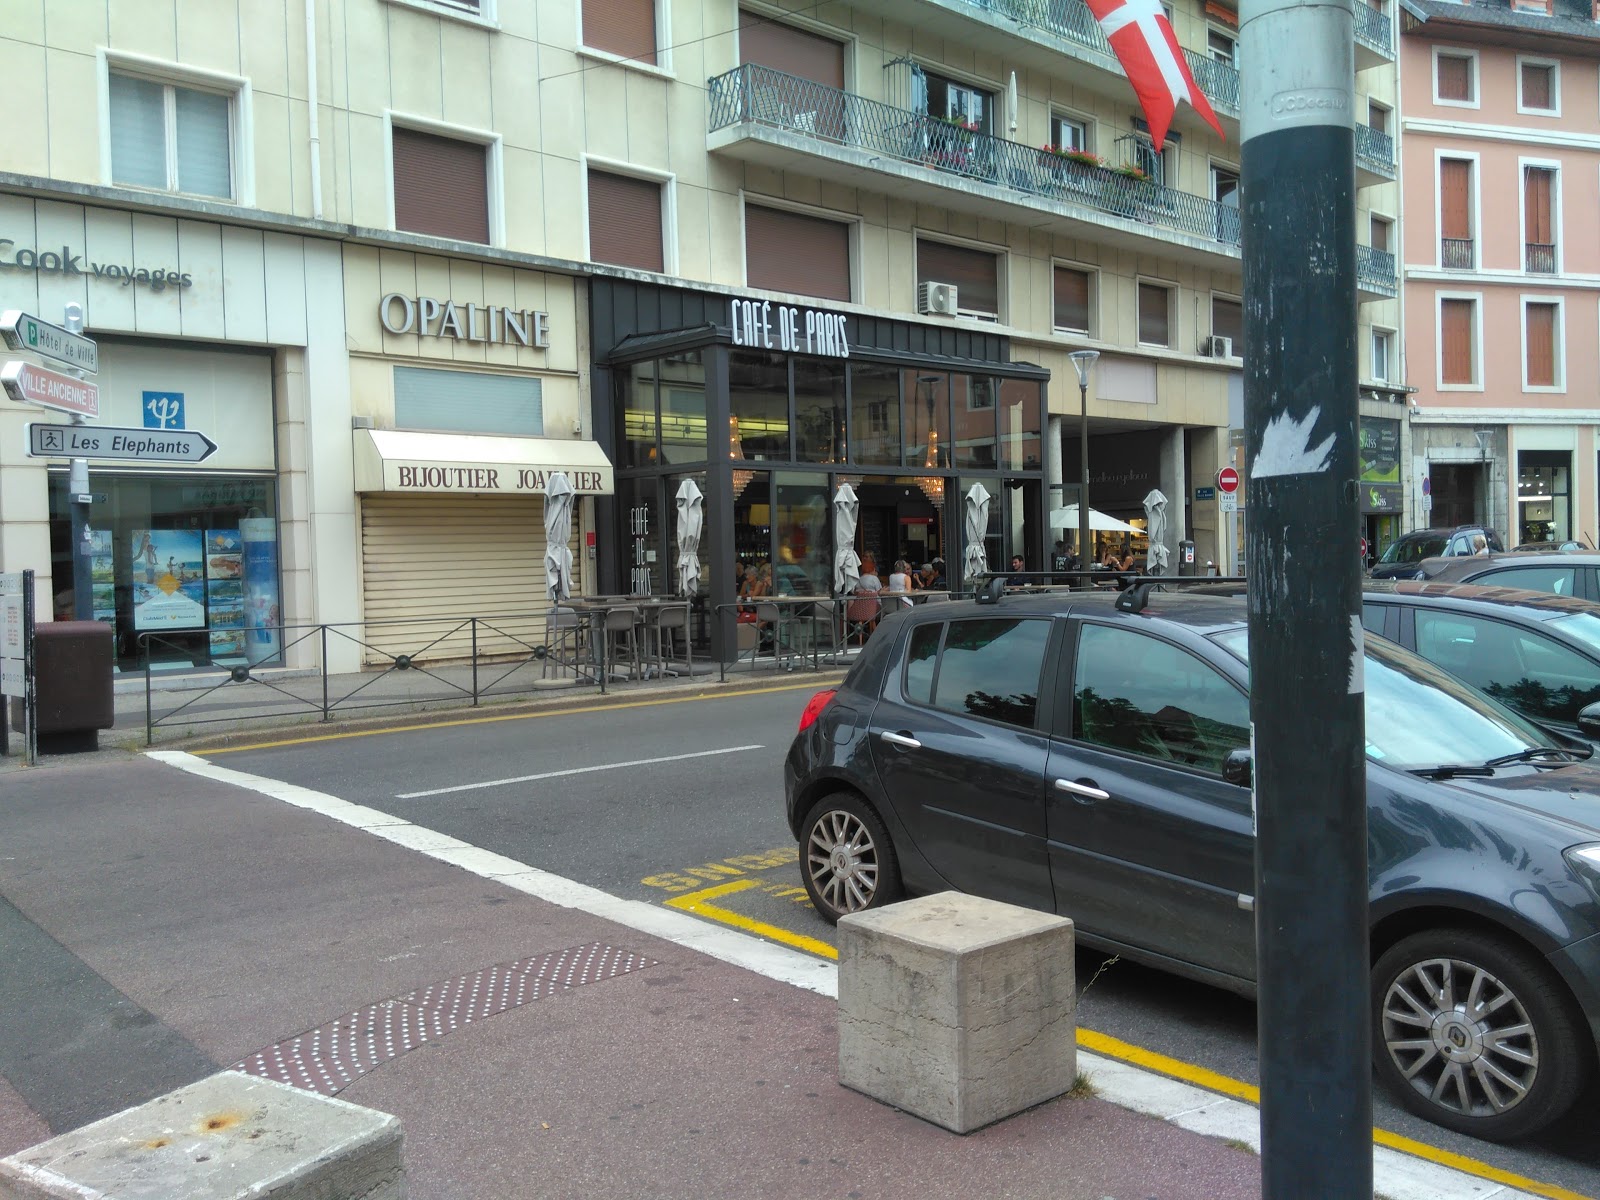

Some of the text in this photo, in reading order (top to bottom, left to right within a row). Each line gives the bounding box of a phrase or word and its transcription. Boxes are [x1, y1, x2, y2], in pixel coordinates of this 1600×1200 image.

[0, 238, 193, 291] Cook voyages
[380, 292, 549, 349] OPALINE
[731, 298, 849, 359] CAFÉ DE PARIS
[39, 329, 62, 353] Hôtel
[65, 341, 74, 357] de
[77, 344, 94, 364] Ville
[22, 372, 87, 406] VILLE ANCIENNE
[71, 433, 190, 456] Les Elephants
[398, 466, 603, 491] BIJOUTIER JOAIER
[631, 502, 649, 535] CAFÉ
[636, 537, 645, 565] DE
[631, 567, 652, 596] PARIS
